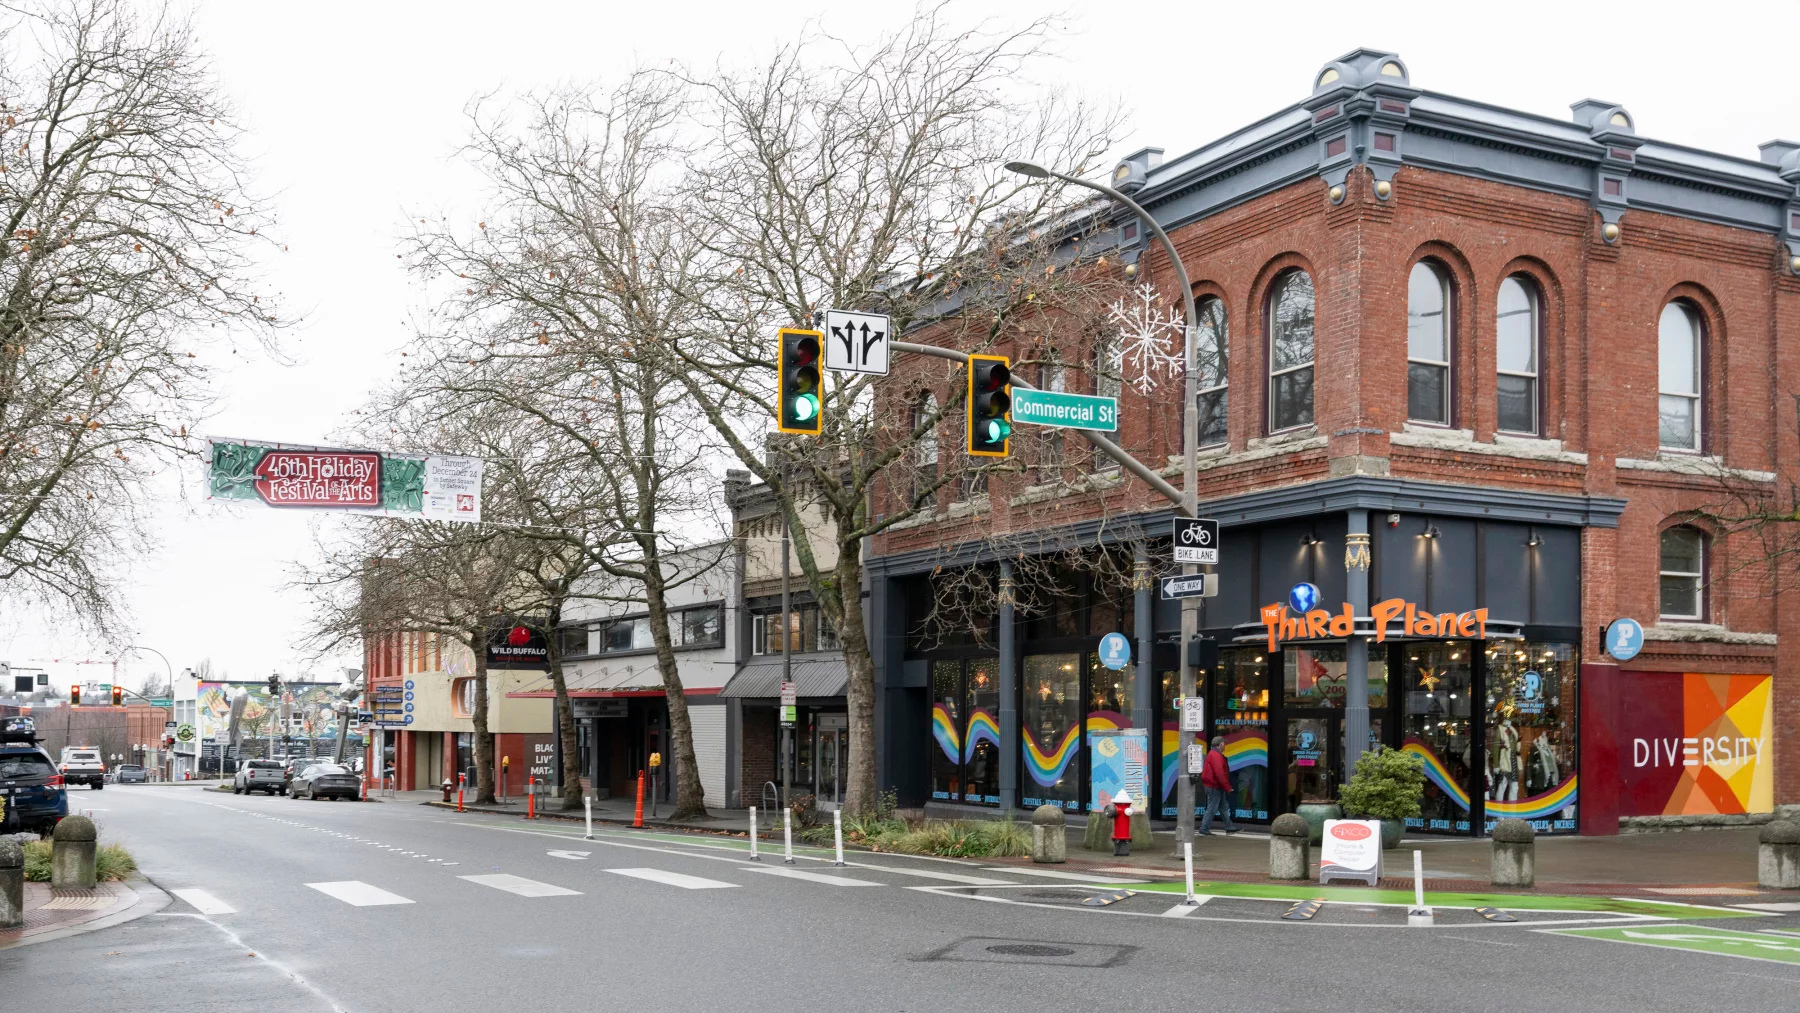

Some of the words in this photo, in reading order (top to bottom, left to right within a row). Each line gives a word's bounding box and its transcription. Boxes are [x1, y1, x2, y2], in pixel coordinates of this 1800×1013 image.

[1015, 396, 1093, 421] Commercial
[1099, 405, 1113, 423] St
[440, 457, 471, 469] Through
[267, 455, 308, 478] 46th
[307, 455, 375, 483] Holiday
[431, 465, 468, 477] December
[469, 470, 478, 478] 24
[268, 478, 330, 501] Festival
[329, 488, 340, 496] THE
[338, 478, 373, 501] Arts
[1177, 549, 1193, 559] BIKE
[1196, 550, 1214, 560] LANE
[1173, 583, 1186, 592] ONE
[1187, 580, 1200, 590] WAY
[1264, 609, 1278, 618] THE
[491, 647, 512, 655] WILD
[512, 647, 547, 655] BUFFALO
[535, 743, 553, 752] BLAC
[1633, 736, 1766, 768] DIVERSITY
[536, 755, 553, 763] LIV
[531, 766, 551, 775] MAT
[1022, 797, 1042, 807] CRYSTALS
[1429, 819, 1450, 830] JEWELRY
[1553, 819, 1576, 829] INCENSE
[1334, 827, 1369, 837] FIXCO
